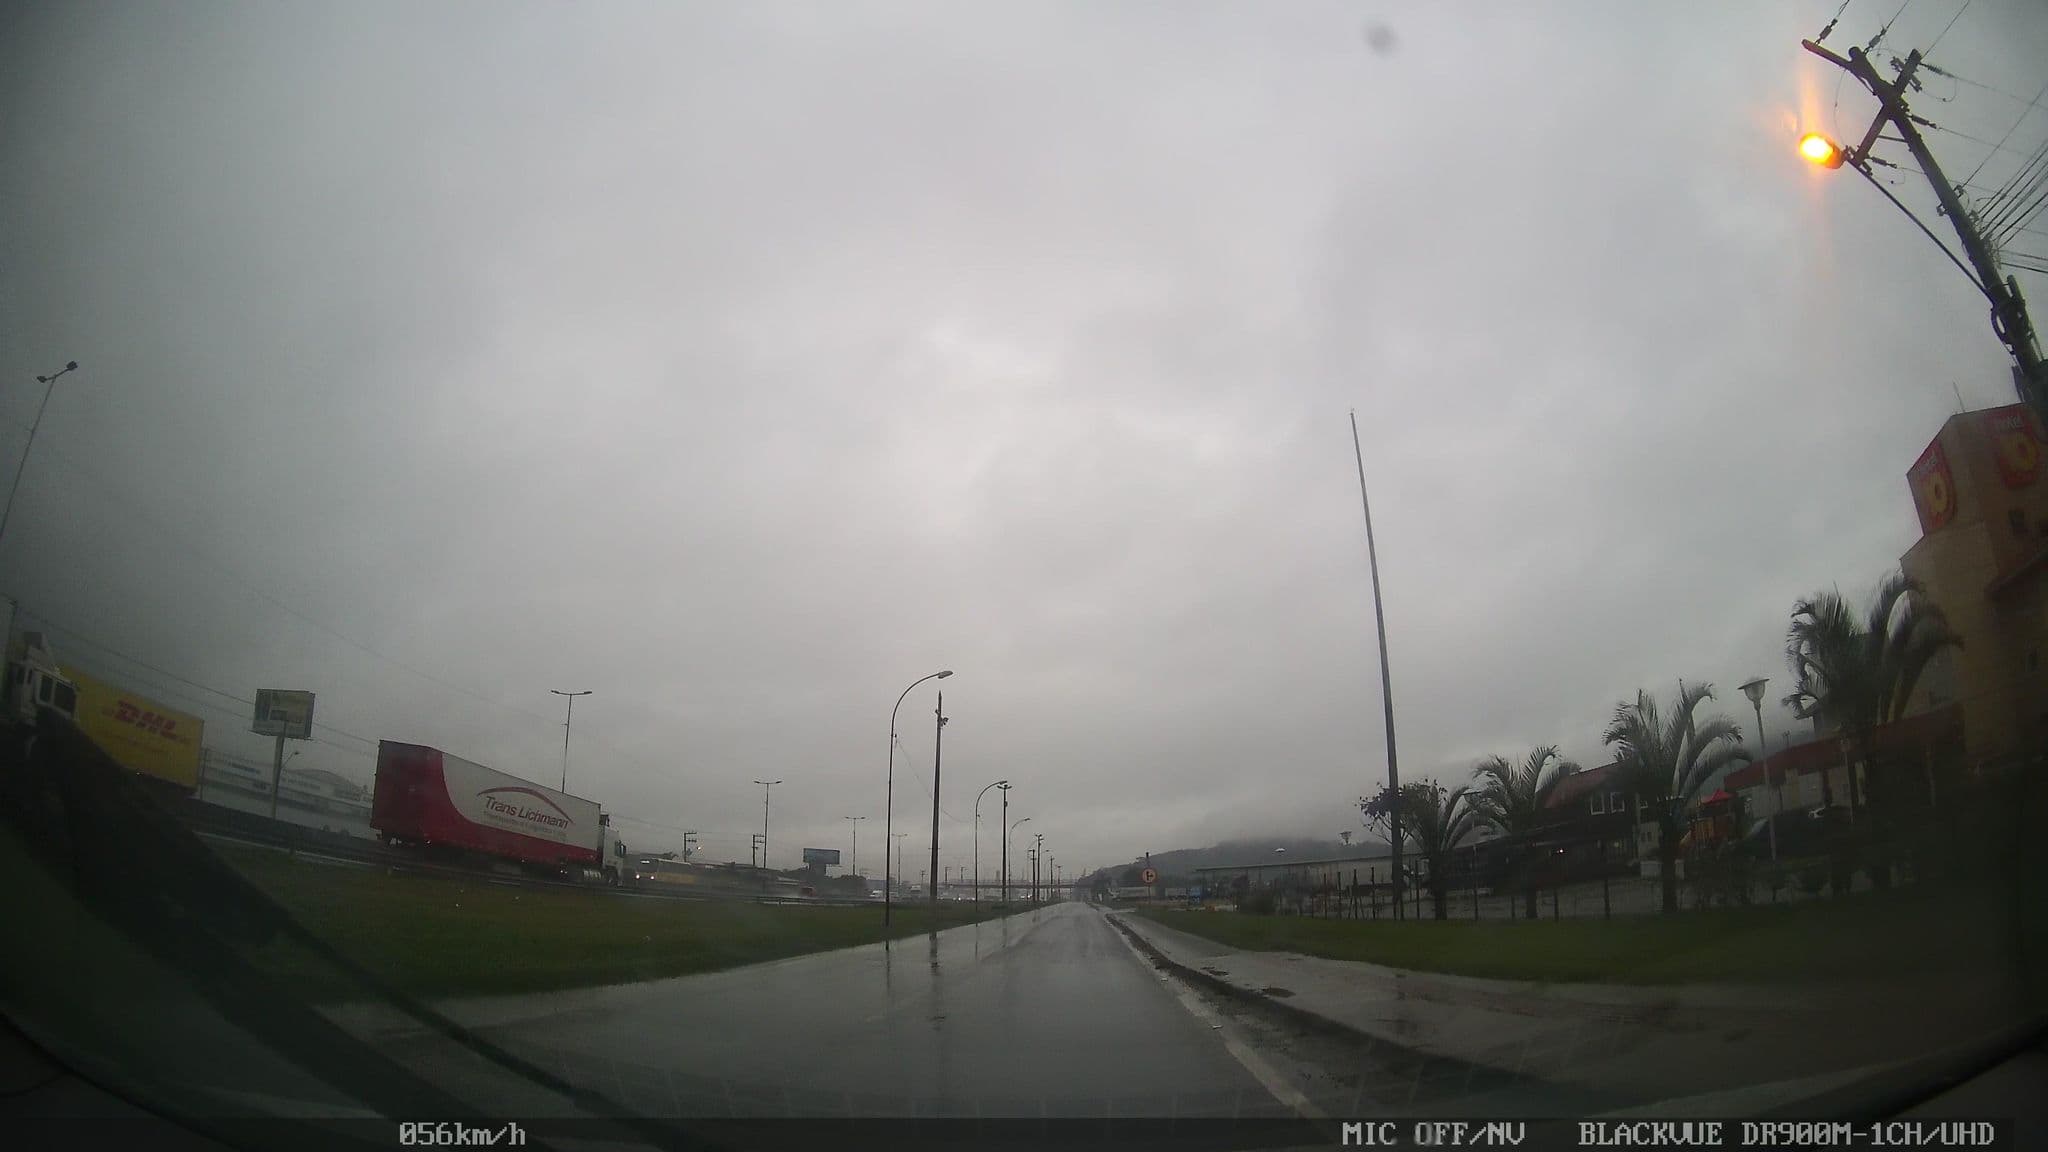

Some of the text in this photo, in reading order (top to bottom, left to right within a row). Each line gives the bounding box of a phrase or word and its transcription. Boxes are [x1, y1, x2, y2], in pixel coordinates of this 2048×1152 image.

[113, 699, 177, 740] DHL
[485, 795, 517, 816] Trans
[518, 806, 569, 829] Lichmann
